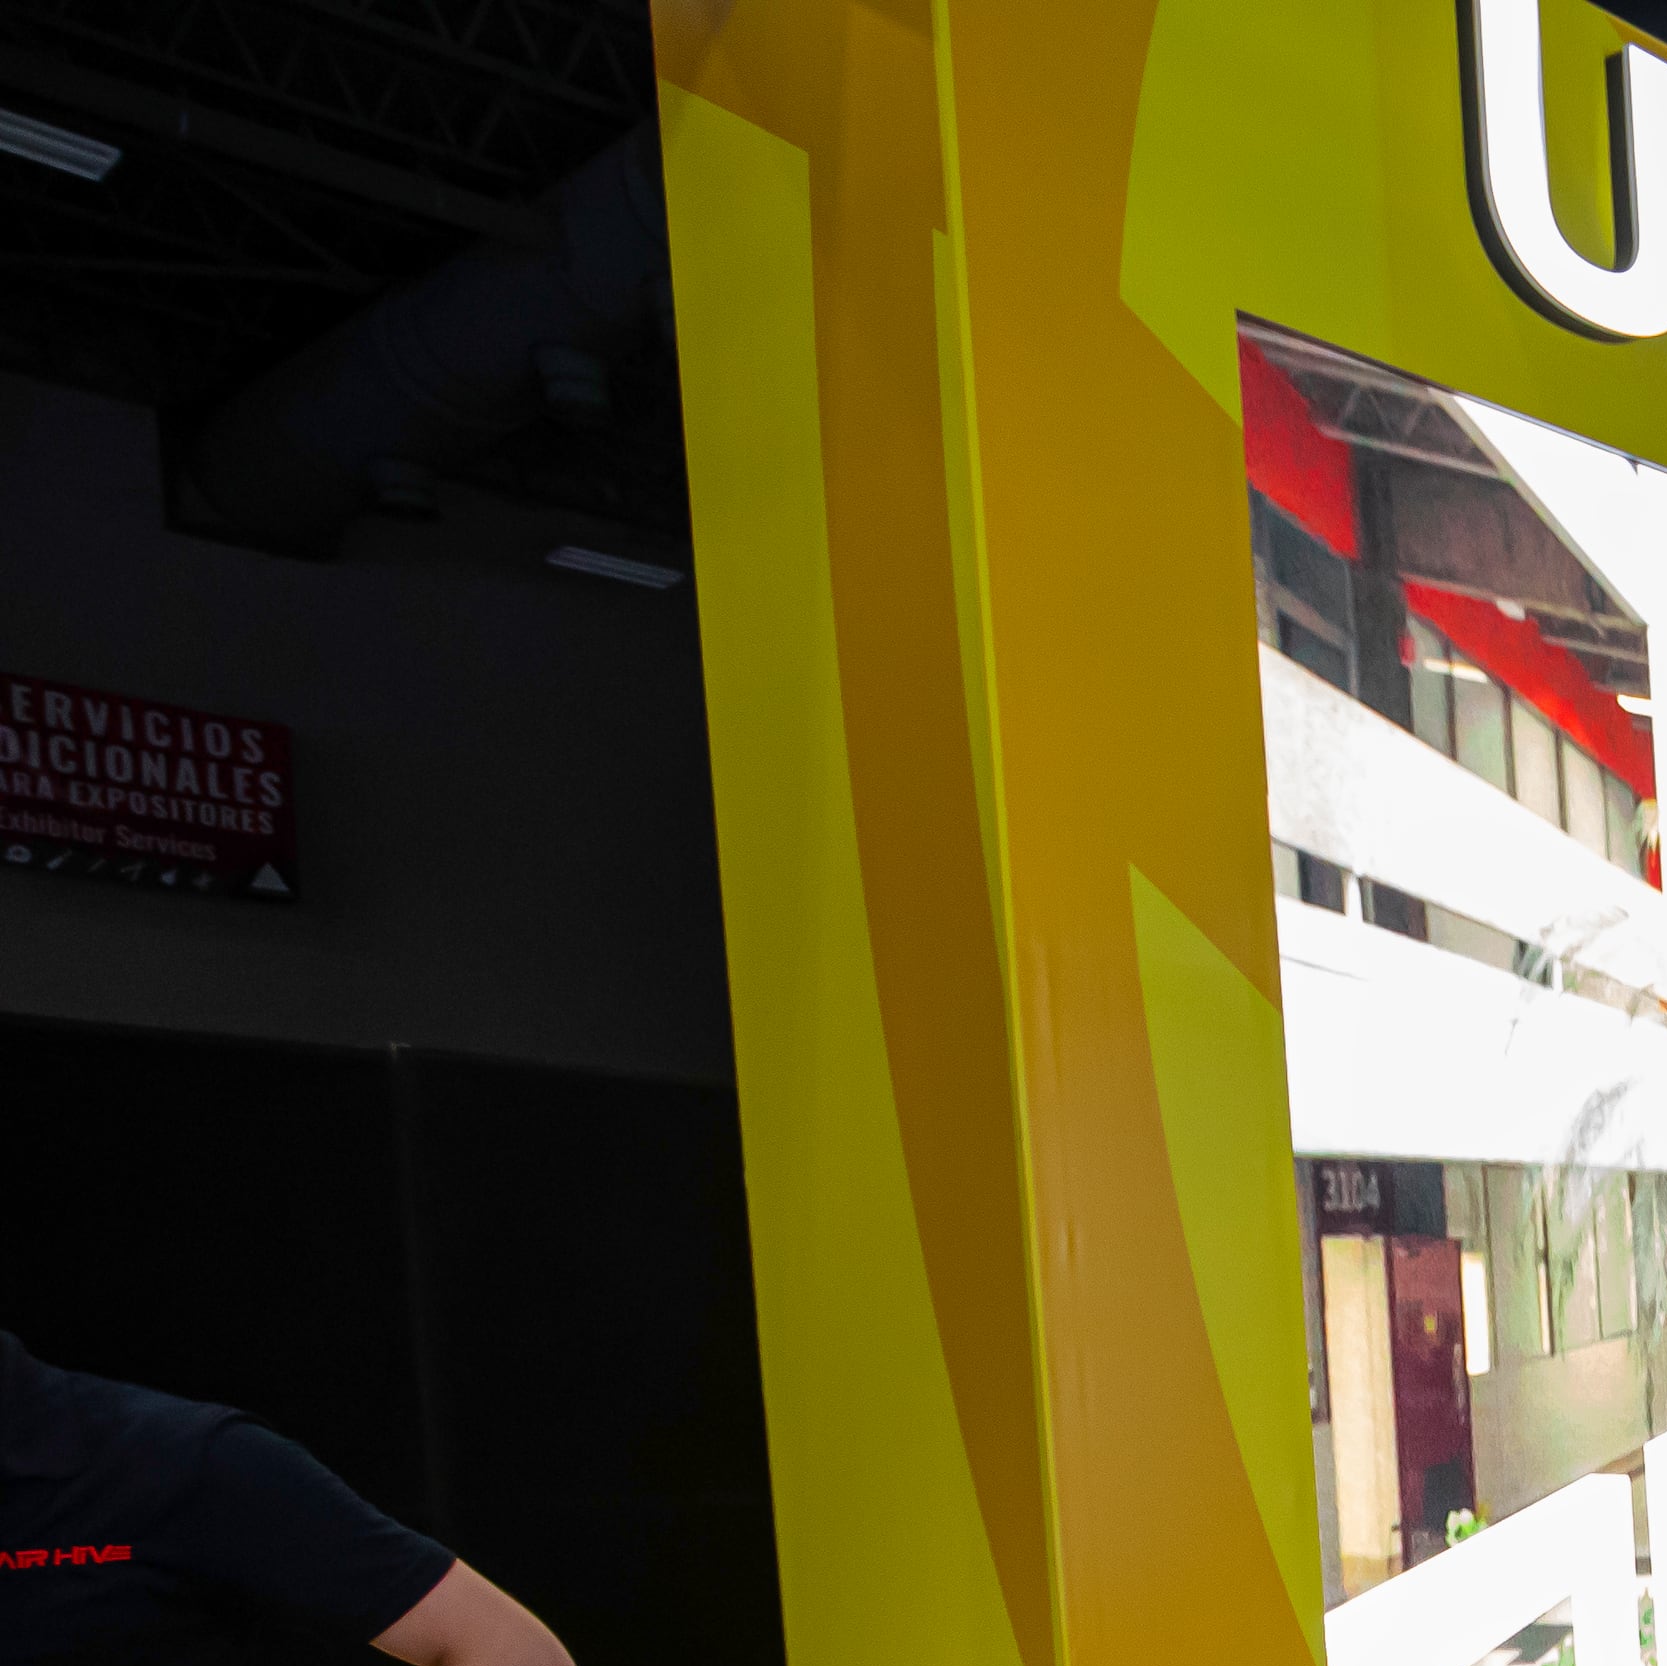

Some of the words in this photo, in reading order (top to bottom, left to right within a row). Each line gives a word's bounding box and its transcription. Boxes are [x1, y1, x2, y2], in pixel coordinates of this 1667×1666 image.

[0, 681, 265, 765] ERVICIOS
[0, 723, 284, 808] DICIONALES
[68, 779, 276, 836] EXPOSITORES
